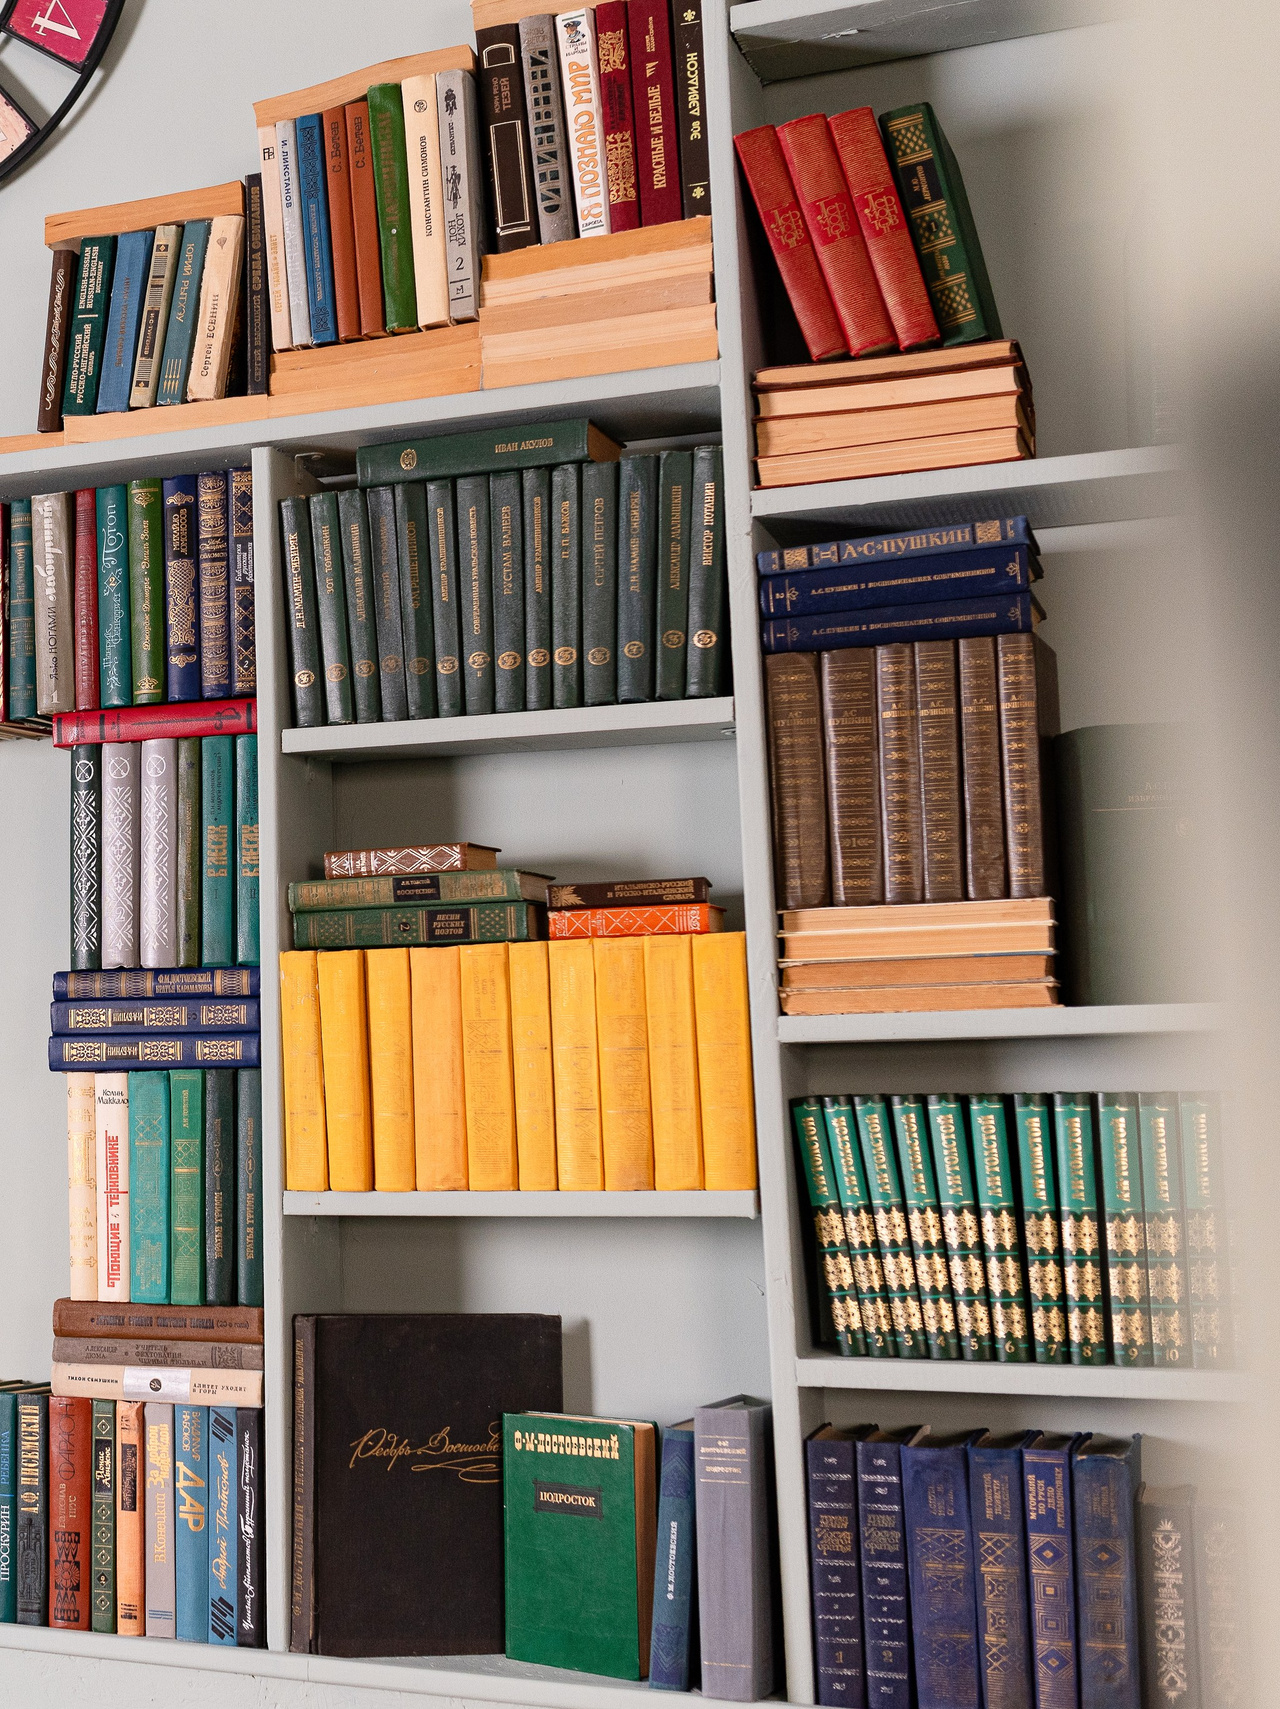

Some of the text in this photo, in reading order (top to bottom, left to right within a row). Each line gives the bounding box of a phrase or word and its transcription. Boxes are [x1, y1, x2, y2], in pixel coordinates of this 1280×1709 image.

[647, 84, 663, 125] БЕЛЫЕ
[686, 52, 701, 116] ДЭВИДСОН
[568, 61, 603, 221] Я ПОЗНАЮ МИР
[651, 135, 667, 190] КРАСНЫЕ
[283, 151, 292, 209] ЛИКСТАНОВ
[420, 135, 433, 237] КОНСТАНТИН СИМОНОВ
[78, 247, 91, 309] ENGLISH-RUSSIAN
[87, 246, 99, 308] RUSSIAN-ENGLISH
[176, 243, 194, 323] ЮРИЙ РЫТХЭУ
[455, 257, 464, 271] 2
[200, 294, 219, 377] Сергей ЕСЕНИН
[494, 437, 554, 454] ИВАН АКУЛОВ
[468, 505, 478, 538] ПОВЕСТЬ
[501, 505, 512, 595] РУСТАМ ВАЛЕЕВ
[561, 500, 570, 534] БАЖОВ
[593, 497, 605, 586] СЕРГЕЙ ПЕТРОВ
[670, 485, 682, 590] АЛЕКСАНДР МАЛЫШКИН
[702, 482, 716, 566] ВИКТОР ПОТАНИН
[321, 525, 334, 594] ЗОТ ТОБОЛКИН
[47, 606, 58, 654] НОГАМИ
[18, 1404, 40, 1485] ПИСЕМСКИЙ
[175, 1461, 205, 1532] ДАР
[539, 1491, 596, 1507] ПОДРОСТОК
[0, 1505, 10, 1582] ПРОСКУРИН
